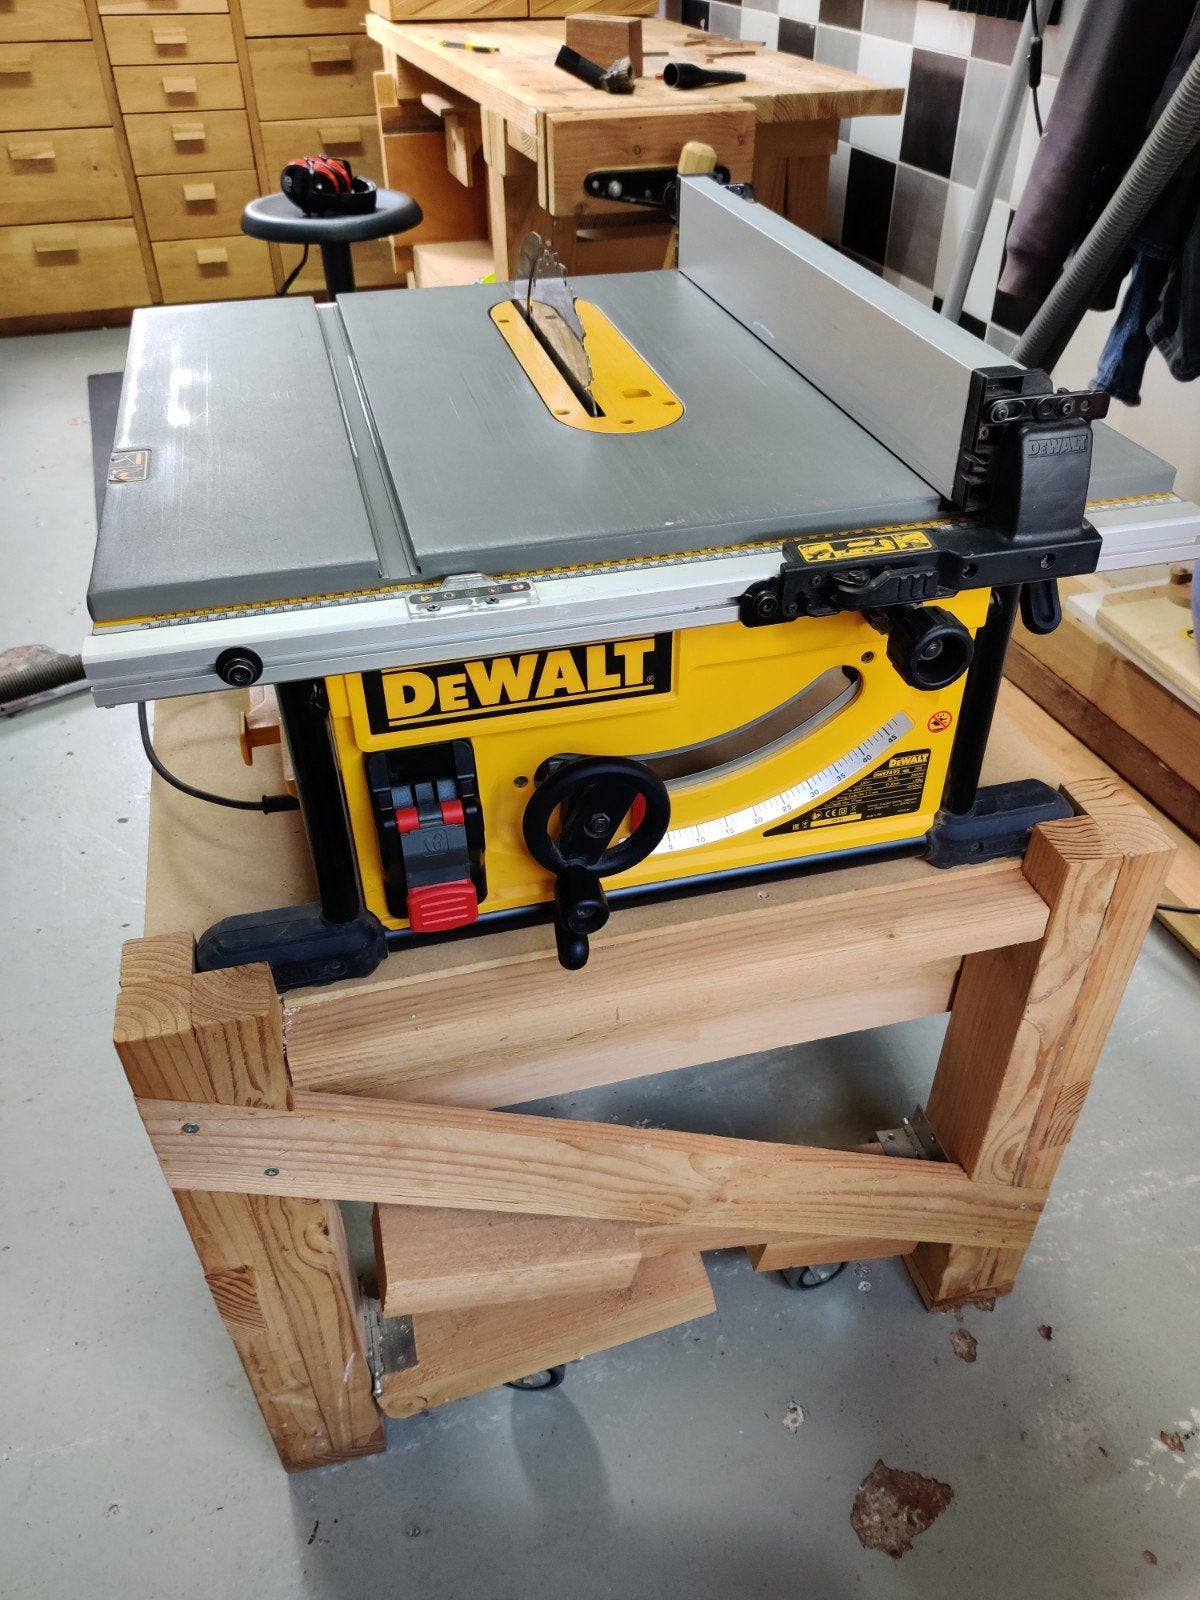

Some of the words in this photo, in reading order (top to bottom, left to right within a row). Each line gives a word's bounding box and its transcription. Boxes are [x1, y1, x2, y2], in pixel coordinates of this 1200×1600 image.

[381, 638, 655, 720] DEWALT
[781, 804, 792, 812] 25
[809, 789, 820, 798] 30
[836, 772, 846, 781] 35
[862, 754, 872, 763] 40
[888, 734, 898, 743] 45
